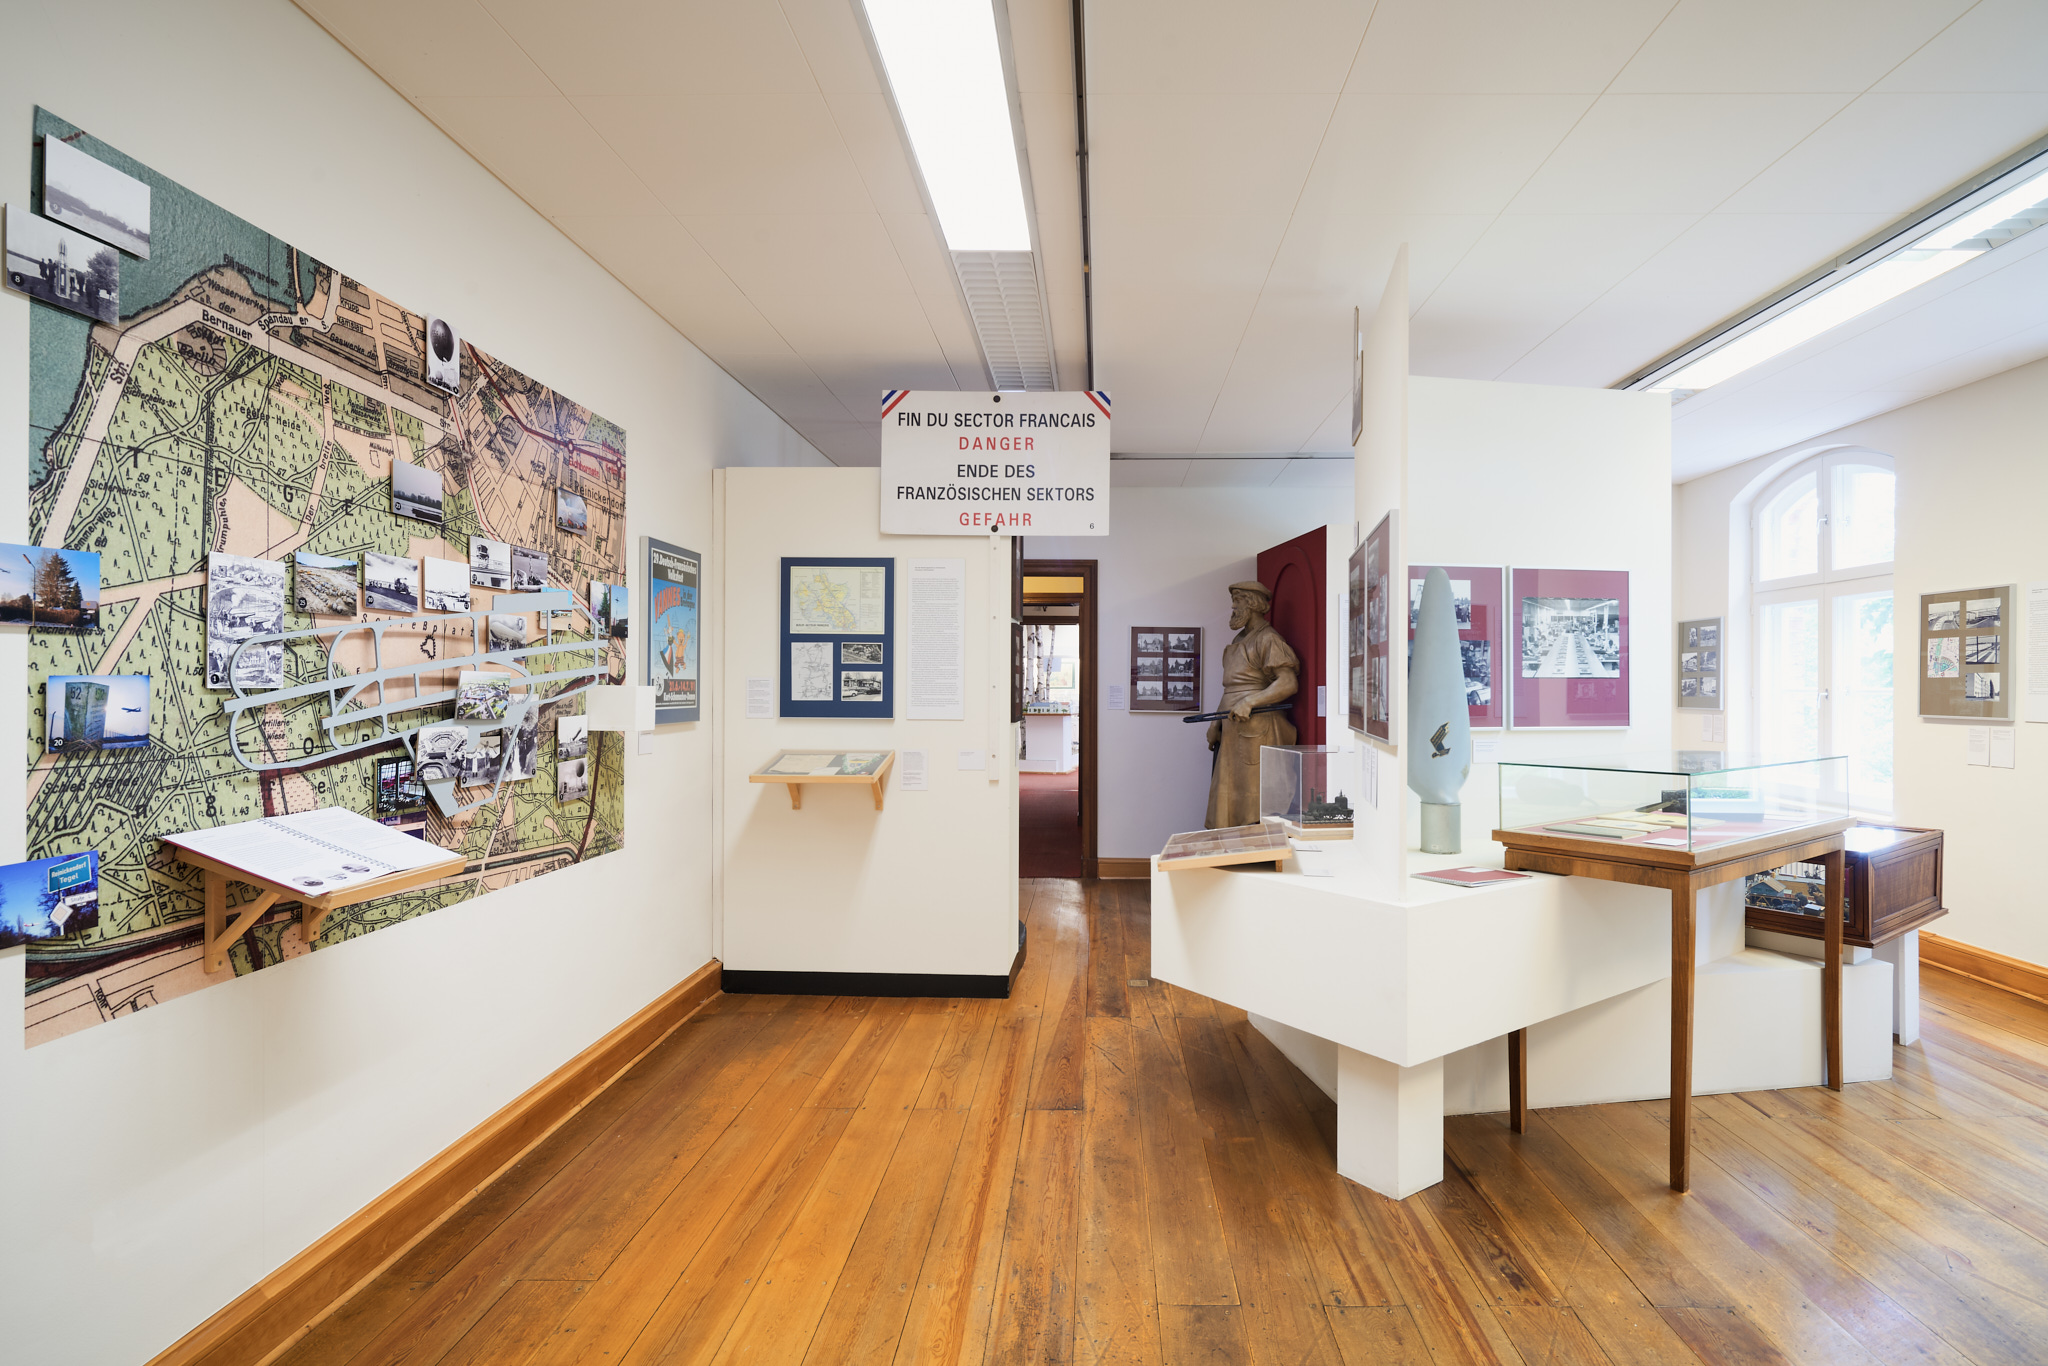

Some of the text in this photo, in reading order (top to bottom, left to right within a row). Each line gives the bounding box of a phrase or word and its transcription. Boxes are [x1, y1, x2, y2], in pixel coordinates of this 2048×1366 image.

[15, 275, 20, 283] 8
[202, 308, 253, 341] Bernauer
[110, 362, 130, 385] Str.
[898, 412, 1096, 428] FIN DU SECTOR FRANCAIS
[959, 436, 1034, 450] DANGER
[137, 472, 150, 483] 59
[957, 464, 1036, 478] ENDE DES
[897, 484, 1095, 501] FRANZÖSISCHEN SEKTORS
[305, 503, 315, 522] Der
[959, 512, 1032, 526] GEFAHR
[654, 586, 681, 623] VANNES
[70, 687, 82, 700] 52
[53, 738, 64, 747] 20
[51, 861, 87, 878] Reinickendorf
[59, 873, 79, 884] Tegel
